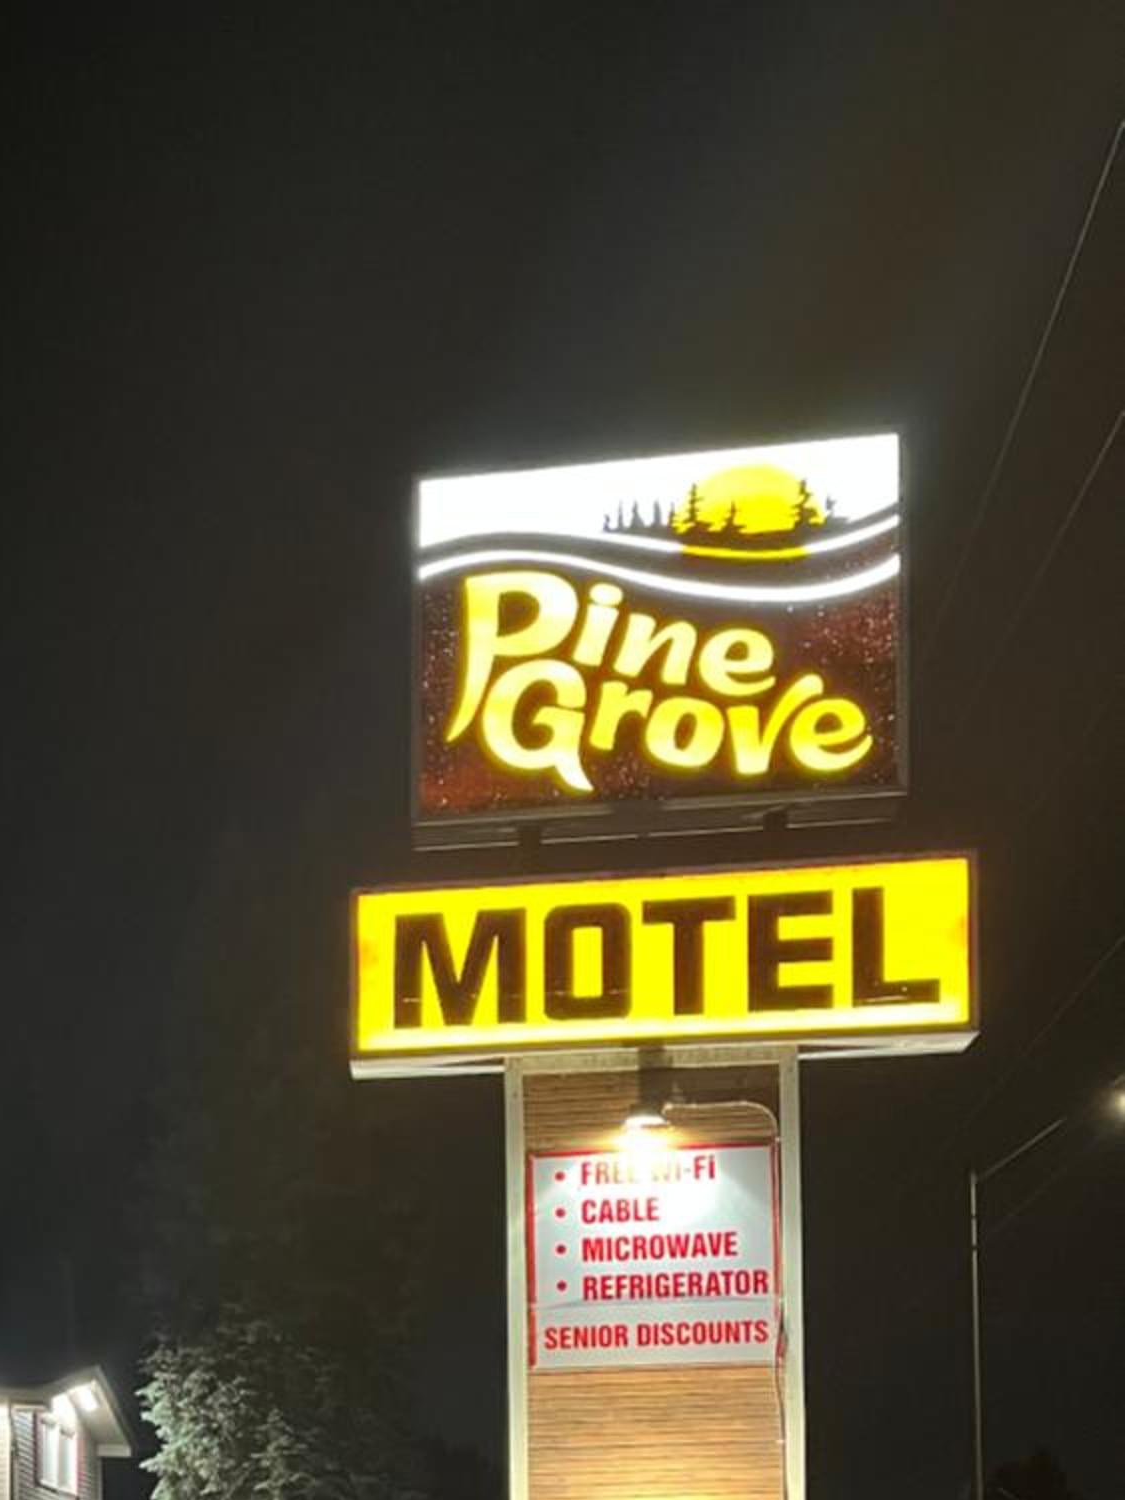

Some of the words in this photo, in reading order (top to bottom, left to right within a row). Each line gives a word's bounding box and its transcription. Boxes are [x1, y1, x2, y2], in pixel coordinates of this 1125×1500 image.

[448, 571, 776, 742] Pine
[482, 659, 873, 793] Grove
[394, 887, 940, 1029] MOTEL
[581, 1199, 660, 1224] CABLE
[582, 1232, 738, 1262] MICROWAVE
[583, 1270, 769, 1300] REFRIGERATOR
[544, 1324, 628, 1349] SENIOR
[637, 1321, 769, 1346] DISCOUNTS
